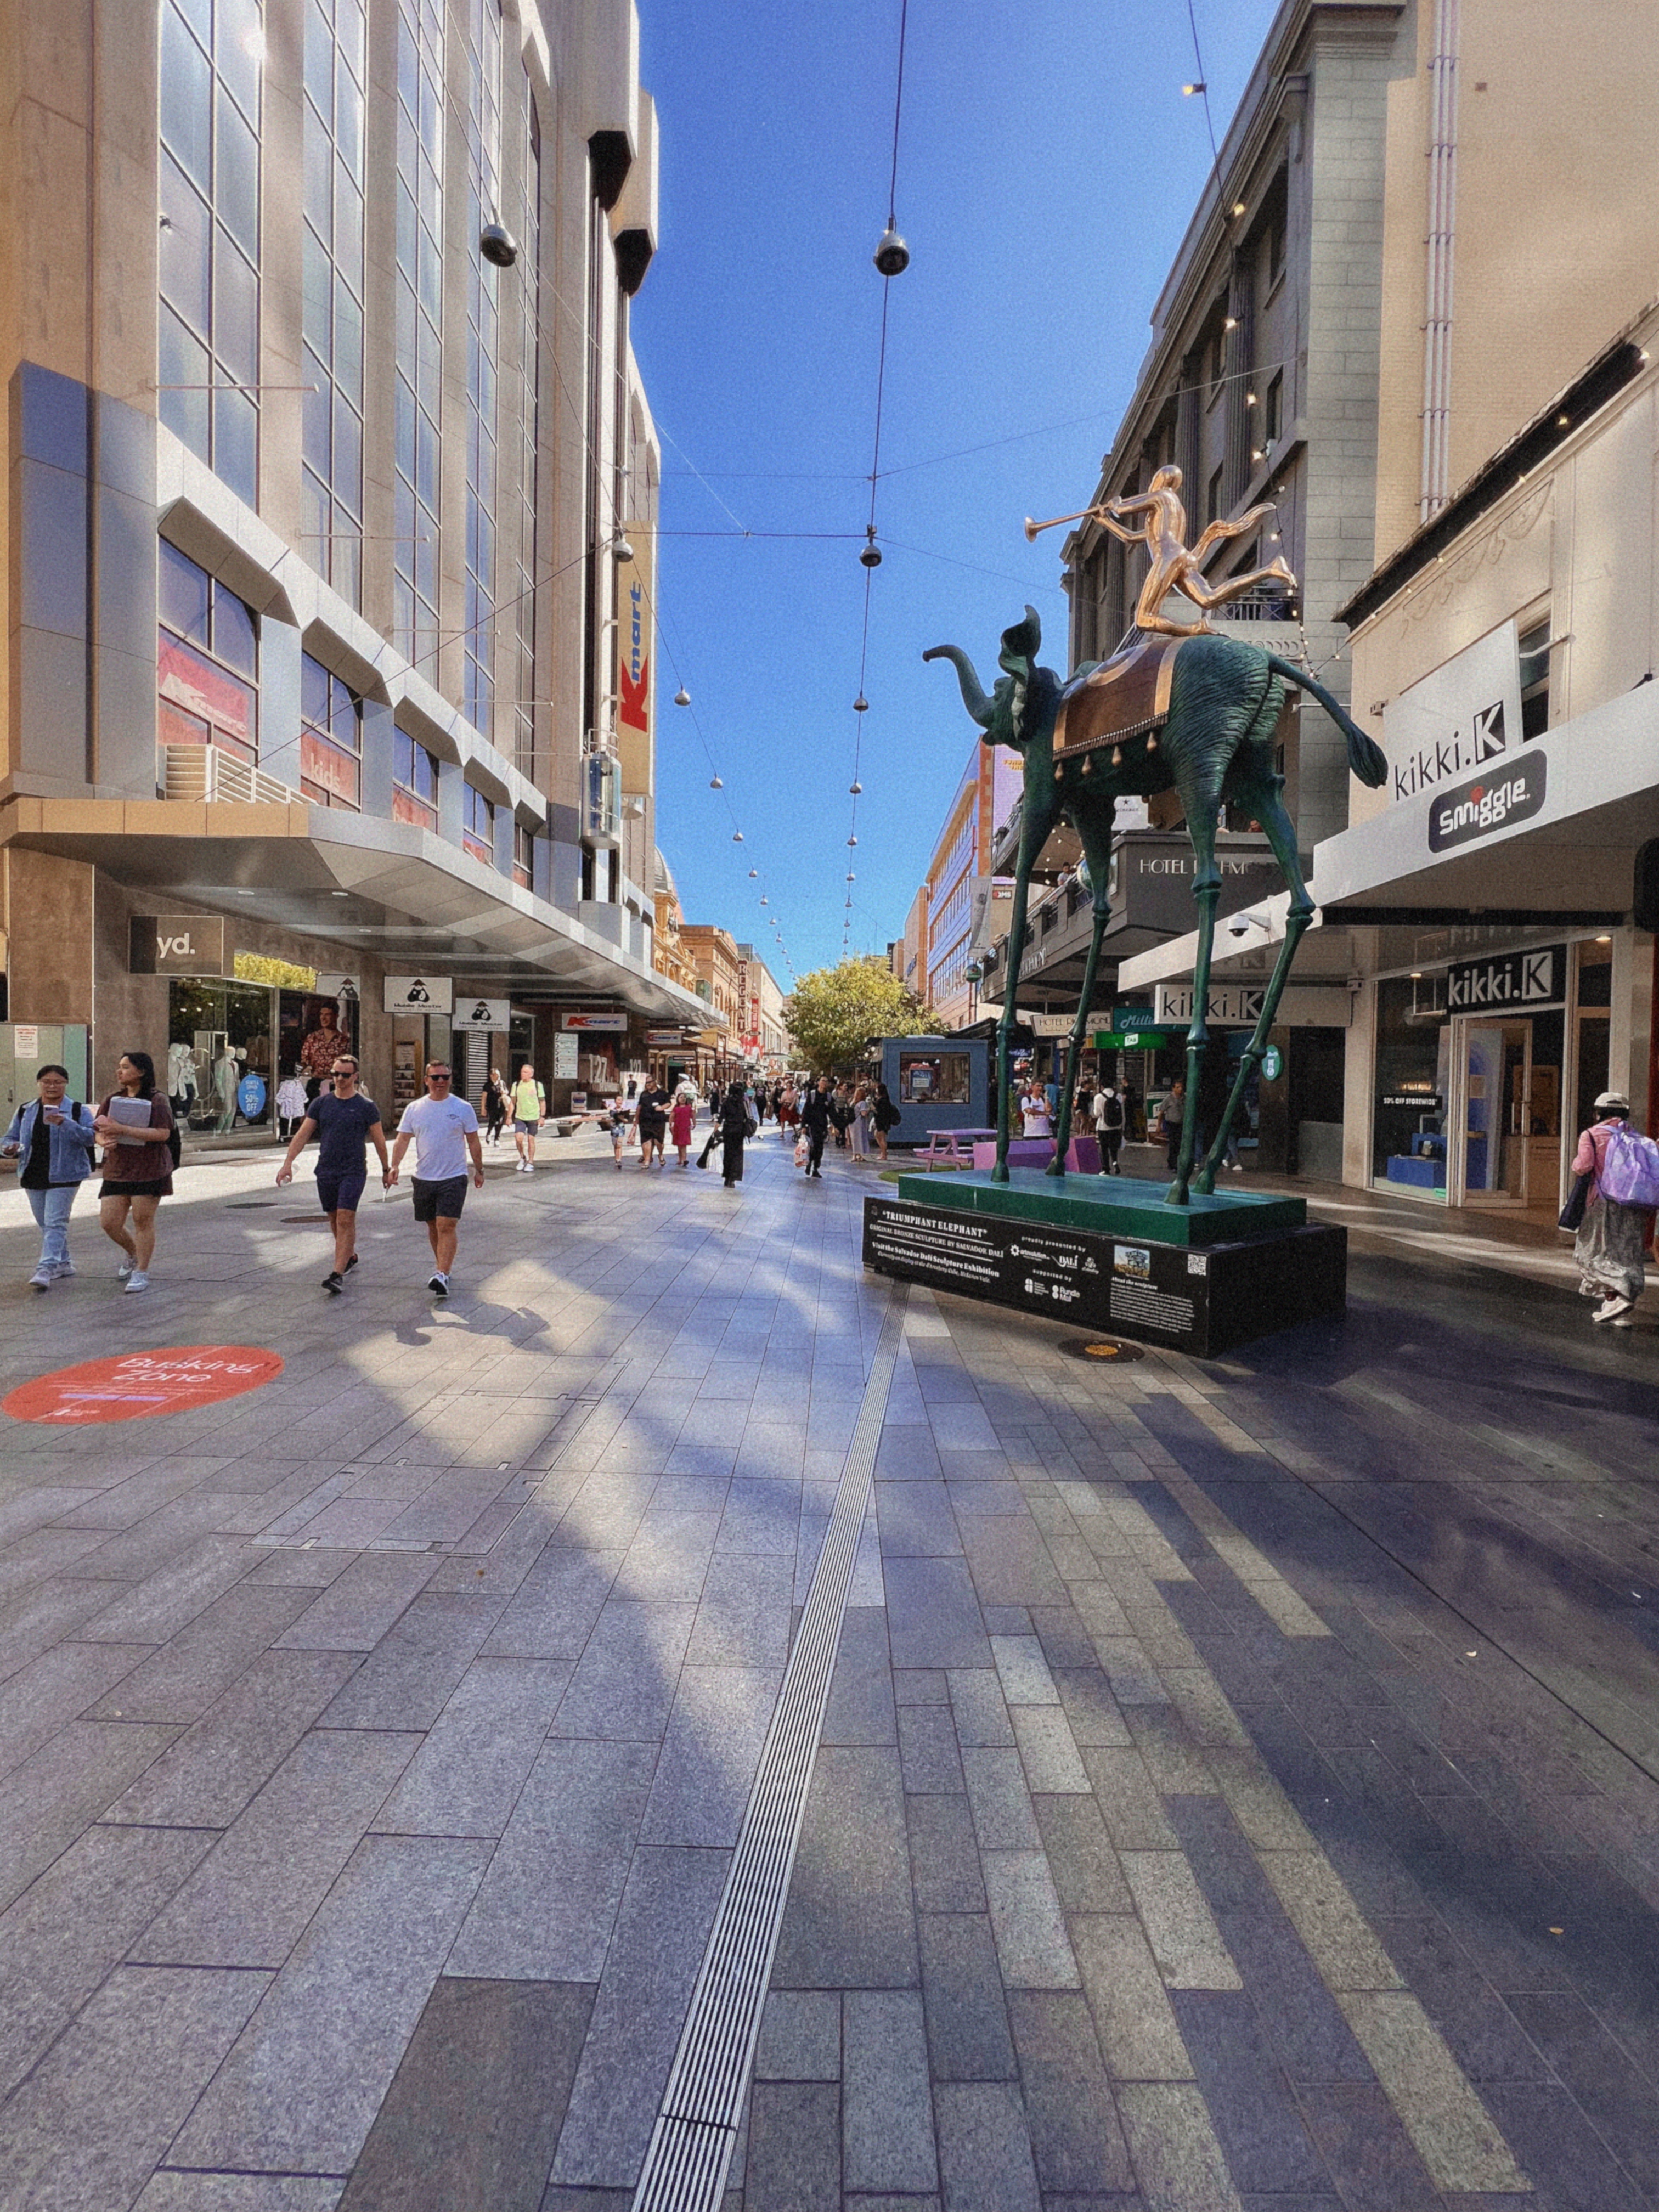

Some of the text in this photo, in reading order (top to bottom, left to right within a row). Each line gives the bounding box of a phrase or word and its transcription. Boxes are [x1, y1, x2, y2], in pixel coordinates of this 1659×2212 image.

[620, 580, 648, 733] Kmart
[161, 672, 247, 733] Kmart
[1395, 699, 1506, 802] kikki.K
[311, 752, 340, 793] kids
[1139, 859, 1188, 874] HOTEL
[156, 932, 195, 958] yd.
[1448, 951, 1553, 1006] kikki.K
[738, 964, 746, 1029] REGENT
[1163, 991, 1264, 1020] kiki.K
[567, 1016, 621, 1027] Kmart
[1120, 1015, 1154, 1029] Milli
[589, 1053, 607, 1084] 127
[245, 1094, 259, 1103] 50%
[246, 1103, 257, 1111] OFF
[870, 1224, 893, 1234] ORIGINAL
[894, 1229, 915, 1239] BRONZE
[915, 1233, 946, 1246] SCULPTURE
[956, 1242, 987, 1255] SALVADOR
[1022, 1236, 1043, 1245] proudly
[1045, 1240, 1076, 1251] presented
[872, 1242, 885, 1250] Visit
[885, 1244, 894, 1252] the
[895, 1246, 919, 1258] Salvador
[933, 1255, 963, 1268] Sculpture
[964, 1263, 1000, 1277] Exhibition
[1032, 1269, 1063, 1279] supported
[112, 1370, 212, 1383] Zone
[117, 1358, 264, 1374] Busking
